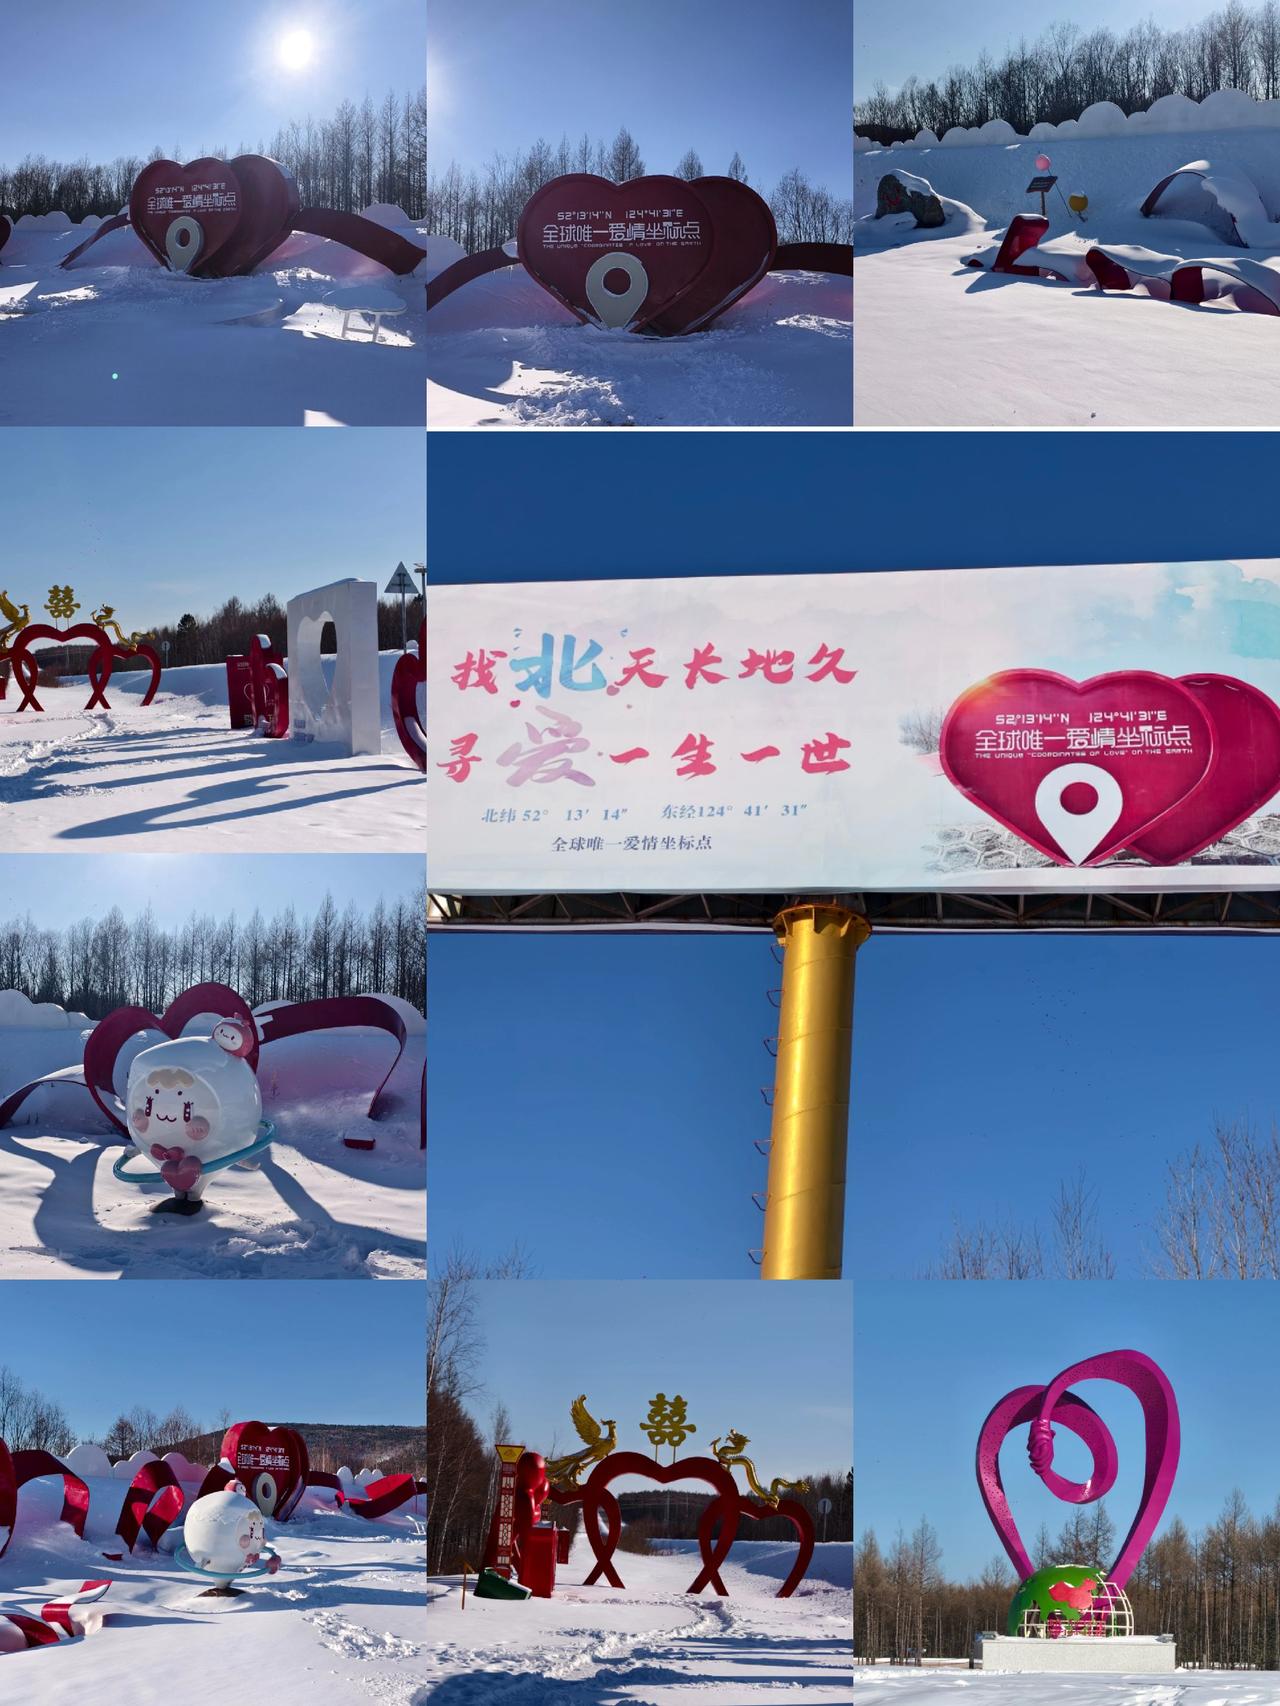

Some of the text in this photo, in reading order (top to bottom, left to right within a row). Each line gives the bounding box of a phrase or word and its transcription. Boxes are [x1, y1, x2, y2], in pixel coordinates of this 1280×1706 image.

[542, 221, 701, 243] 全球唯一爱情坐标点
[975, 725, 1192, 751] 全球唯一爱情坐标点
[552, 835, 712, 852] 全球唯一爱情坐标点
